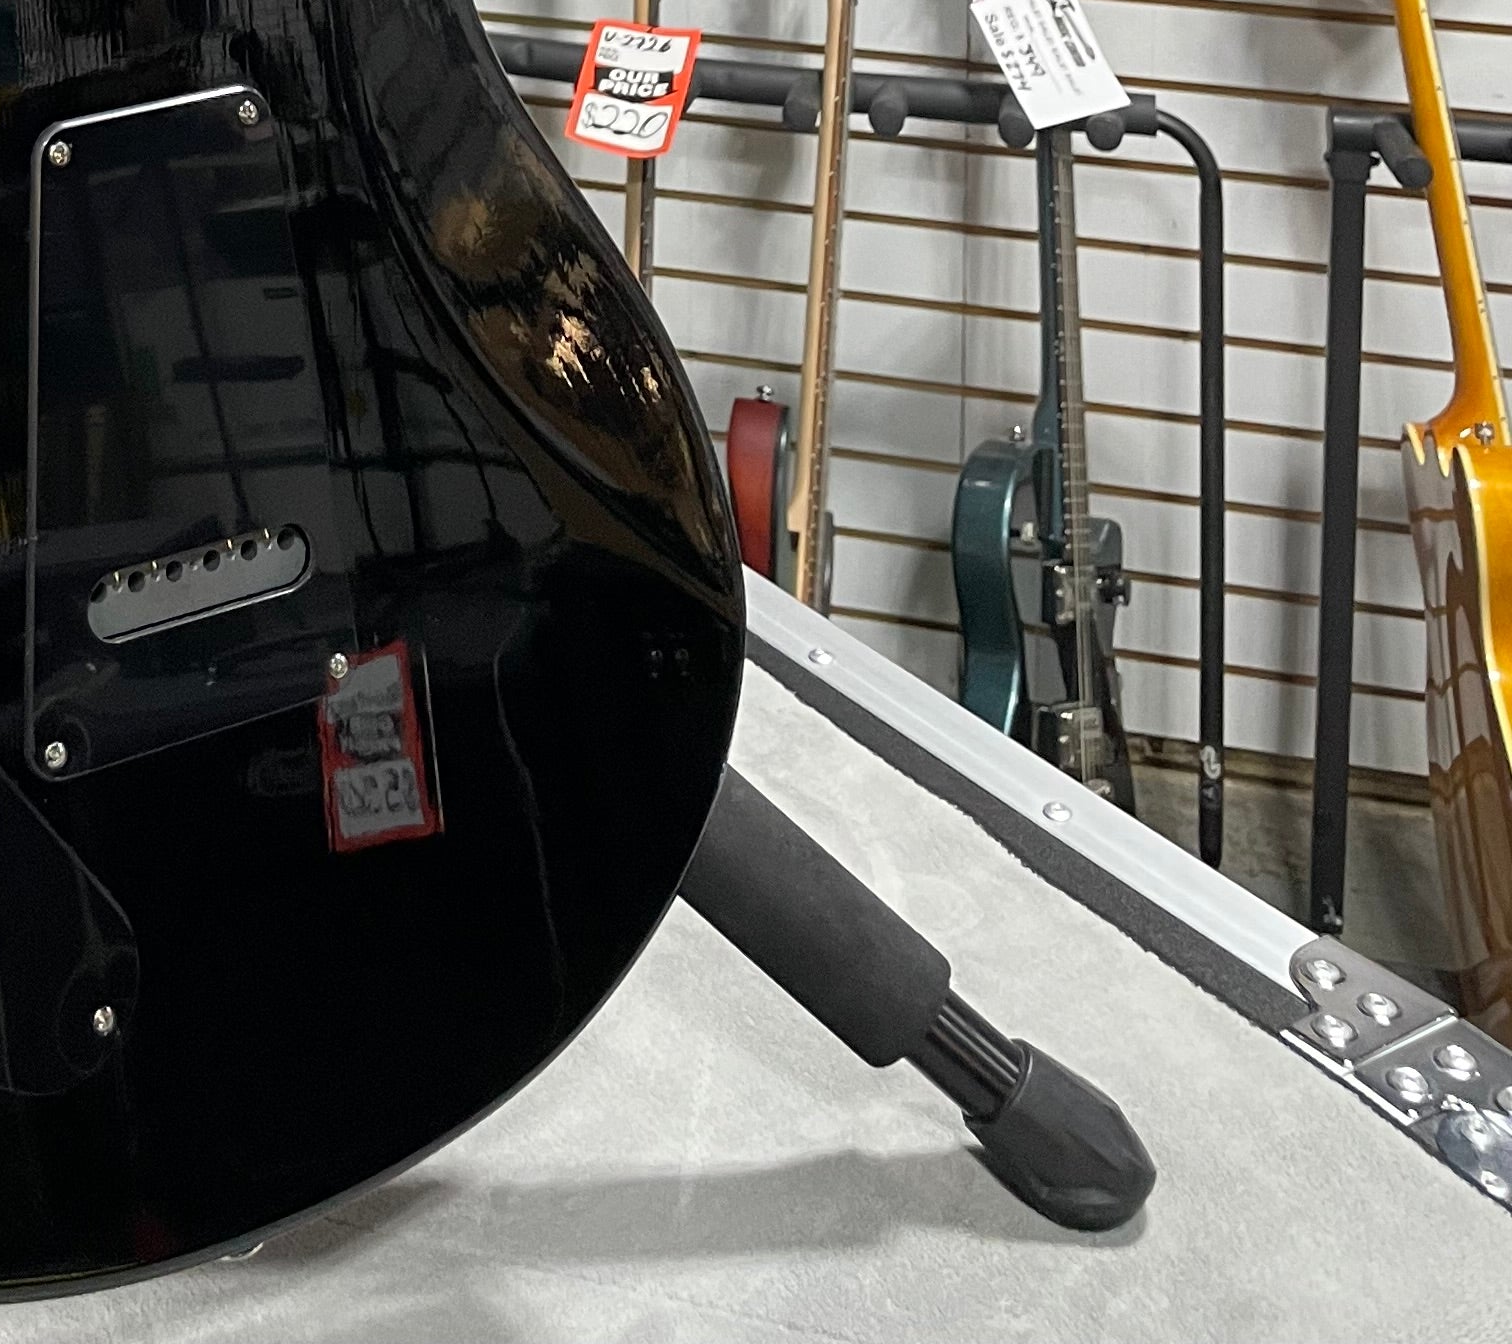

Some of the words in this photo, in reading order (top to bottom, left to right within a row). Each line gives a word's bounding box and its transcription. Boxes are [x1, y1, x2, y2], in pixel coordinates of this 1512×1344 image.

[609, 68, 660, 85] OUR
[598, 78, 670, 98] PRICE
[580, 101, 669, 140] $220
